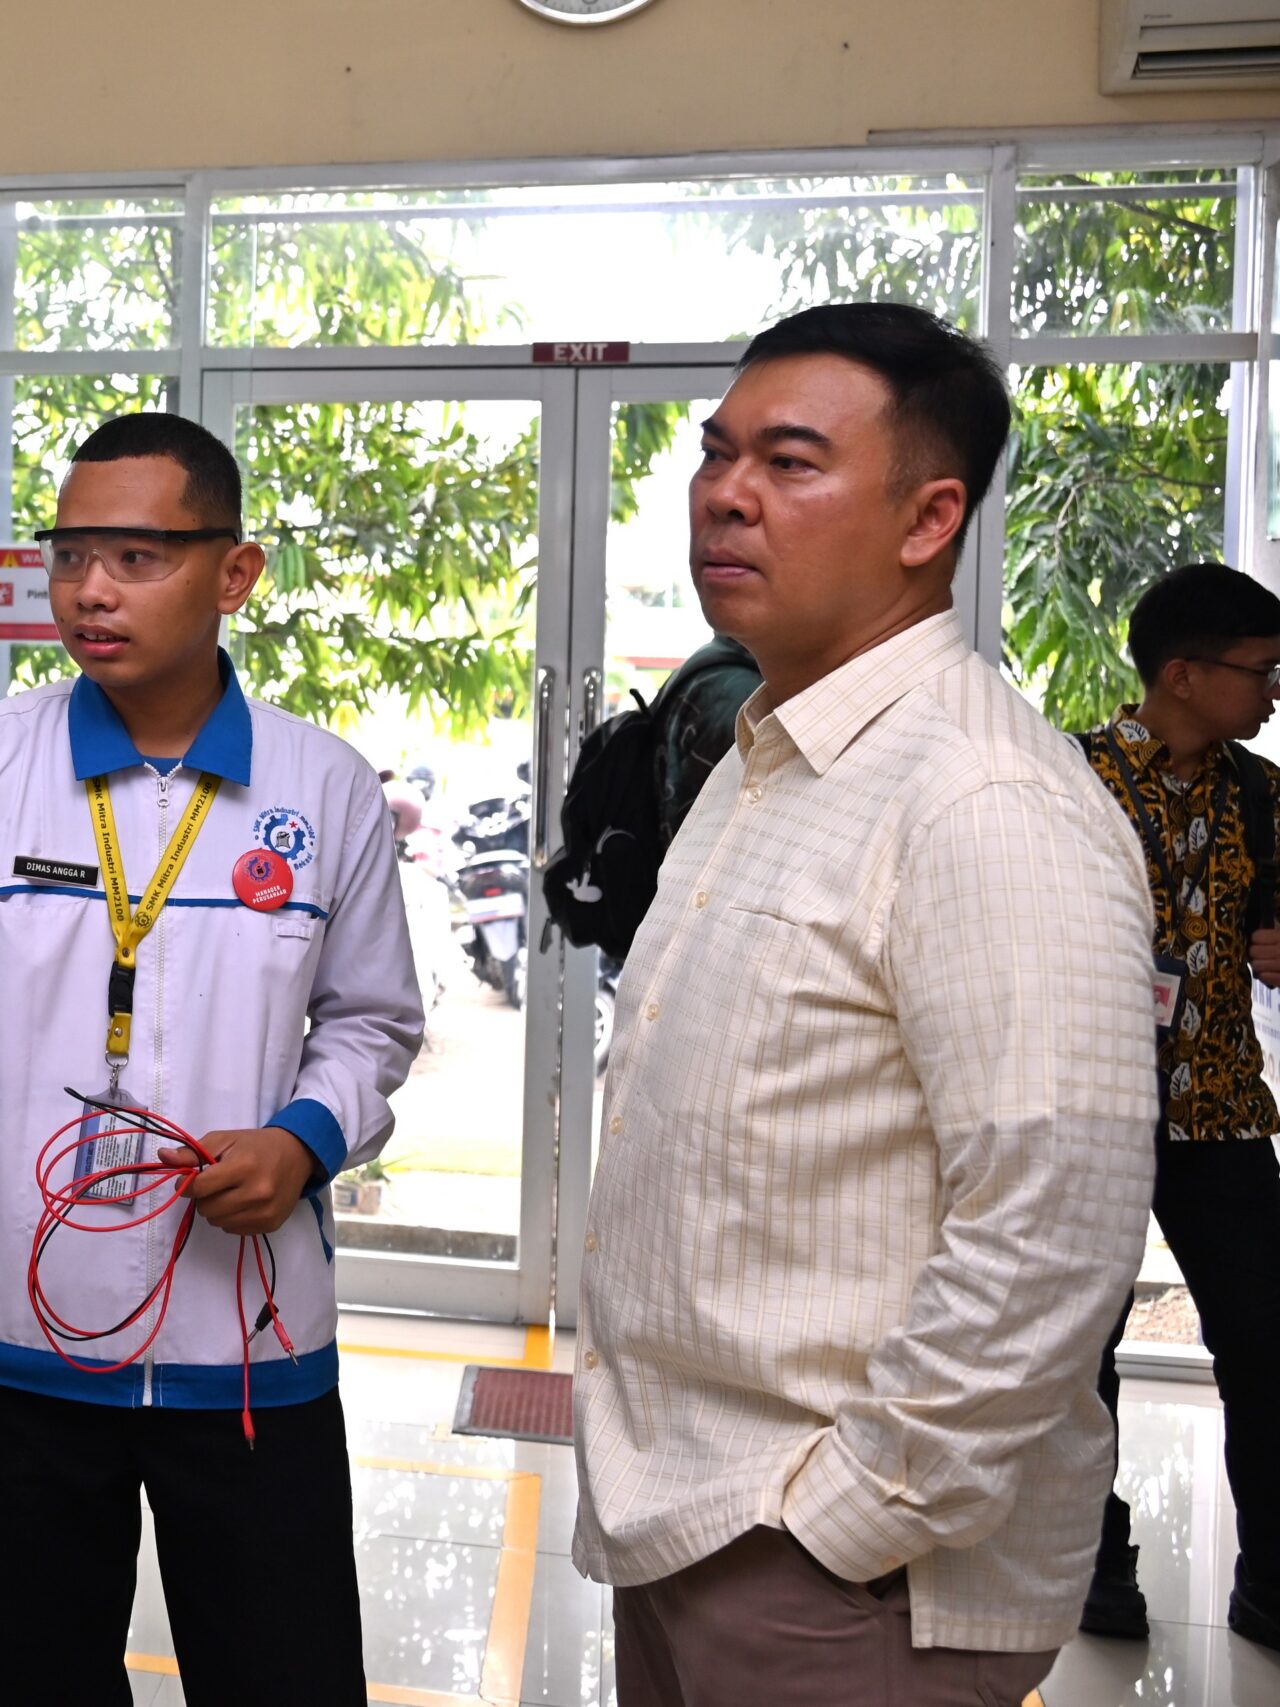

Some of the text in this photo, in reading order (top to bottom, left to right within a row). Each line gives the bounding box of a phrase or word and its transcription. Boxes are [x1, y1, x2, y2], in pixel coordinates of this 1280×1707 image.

[554, 343, 608, 361] EXIT
[27, 588, 49, 599] Pint
[92, 778, 124, 921] SMK Mitra Industri MM2100
[146, 782, 213, 911] SMK Mitra Industri MM2100
[26, 862, 86, 878] DIMAS ANGGA R
[255, 885, 281, 897] MANAGER
